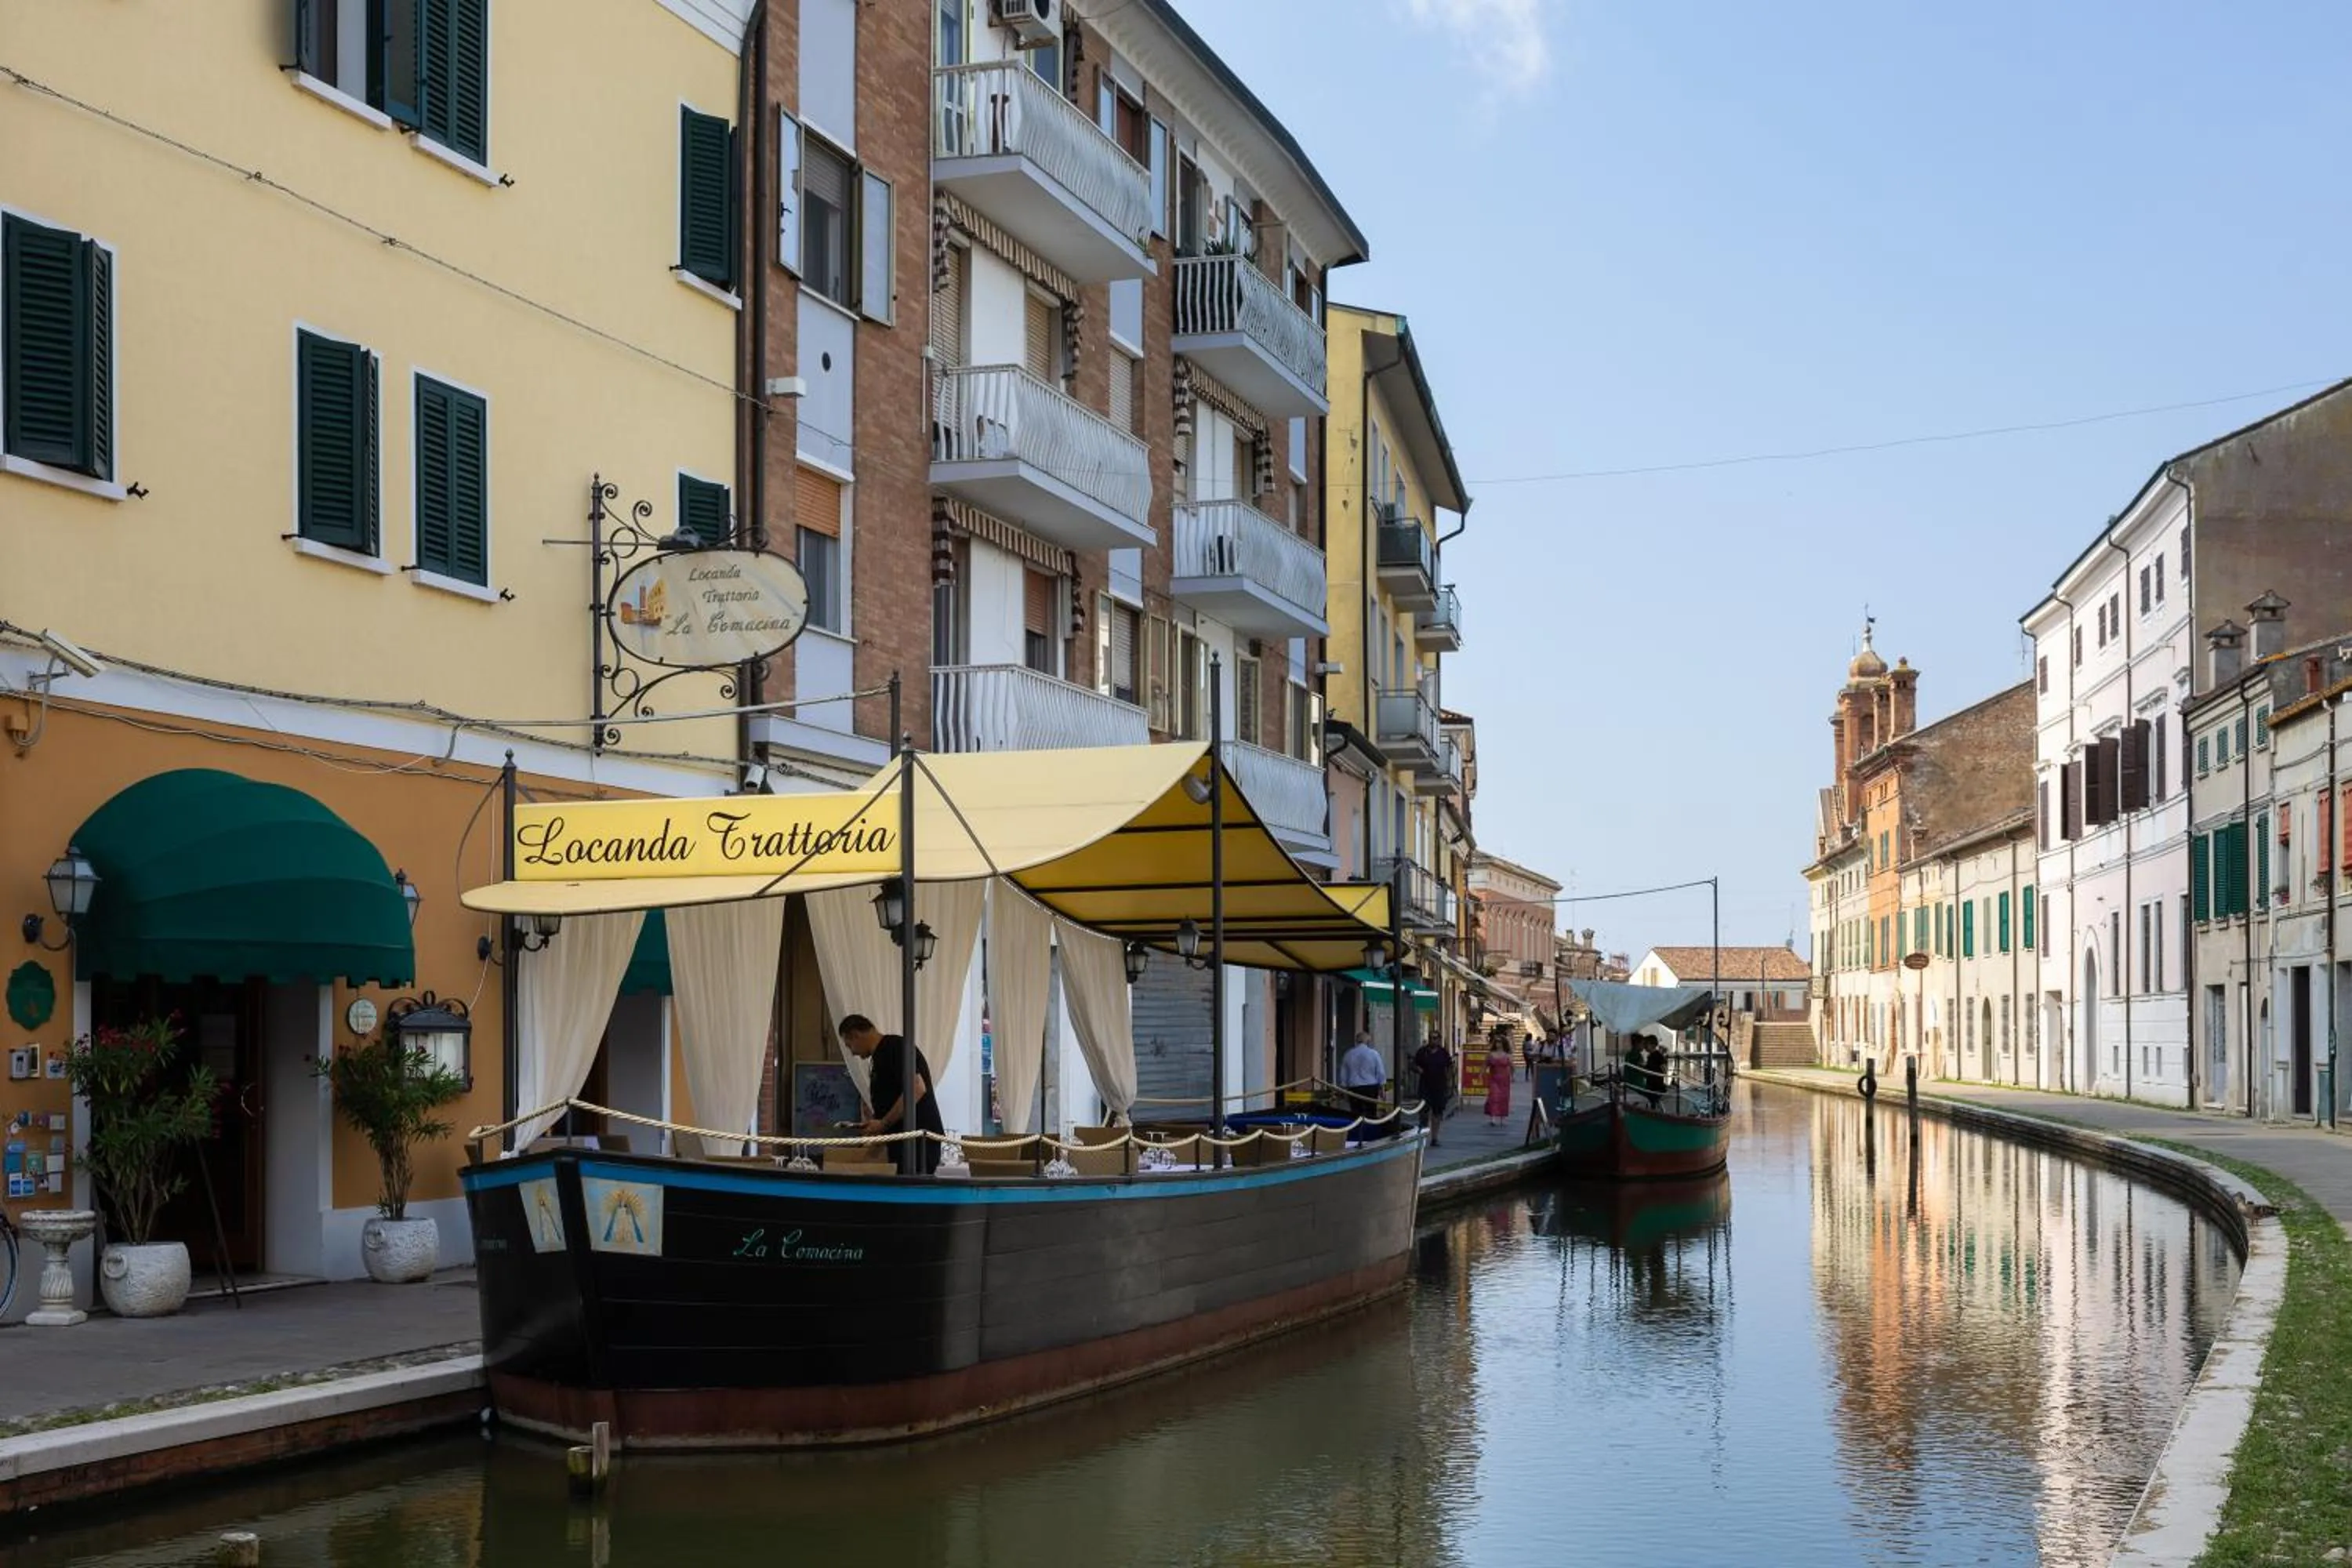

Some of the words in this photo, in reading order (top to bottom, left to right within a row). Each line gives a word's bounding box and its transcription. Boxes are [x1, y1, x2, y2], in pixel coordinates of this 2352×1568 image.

[688, 564, 742, 582] Locanda
[702, 588, 760, 604] Trattoria
[665, 612, 691, 636] La
[707, 610, 791, 633] Comacina
[517, 816, 696, 866] Locanda
[706, 811, 896, 861] Trattoria
[732, 1228, 768, 1258] La
[781, 1229, 864, 1261] Comacina
